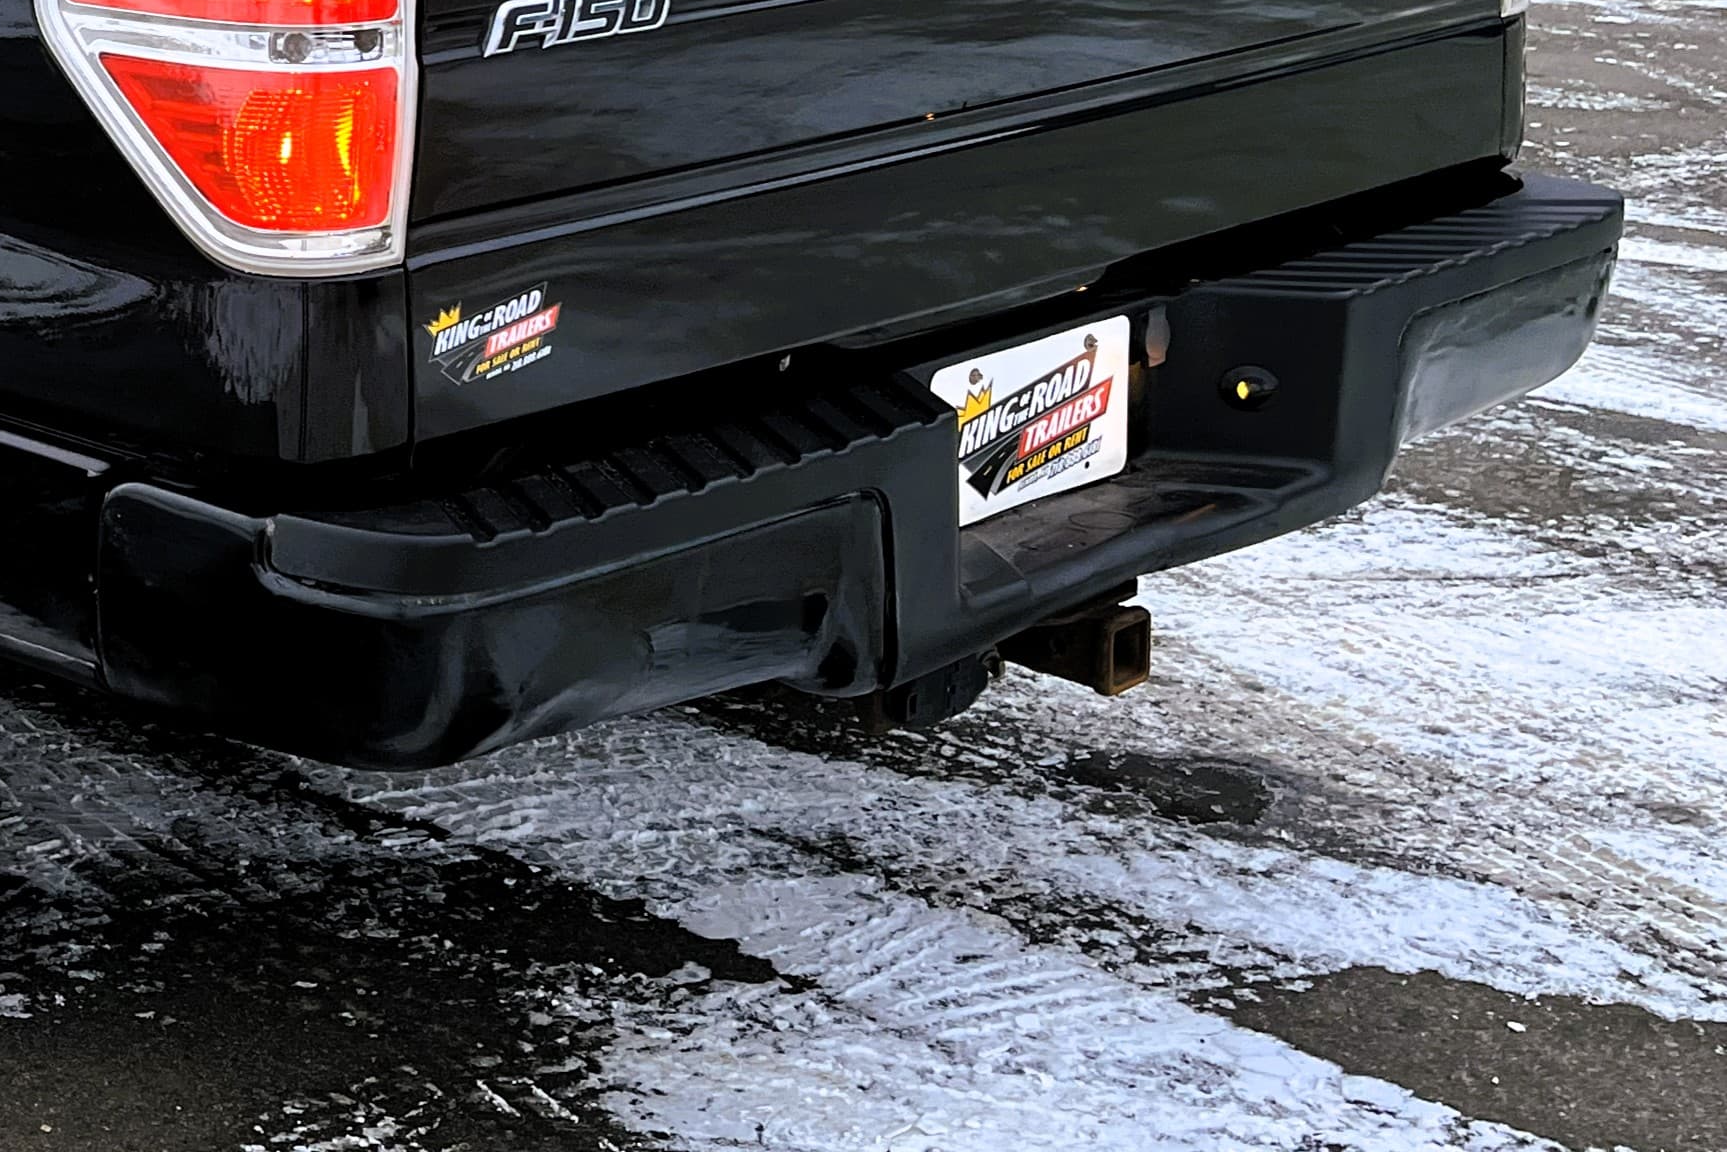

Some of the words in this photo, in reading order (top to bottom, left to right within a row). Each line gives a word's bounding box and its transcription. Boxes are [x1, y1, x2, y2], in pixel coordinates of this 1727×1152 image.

[434, 314, 483, 355] KING
[492, 289, 542, 330] ROAD
[490, 309, 554, 354] TRAILERS
[958, 396, 1018, 459] KING
[1028, 359, 1091, 418] ROAD
[1023, 387, 1105, 453] TRAILERS
[1006, 463, 1025, 484] FOR
[1026, 449, 1047, 472] SALE
[1048, 442, 1062, 459] OR
[1064, 427, 1088, 451] RENT
